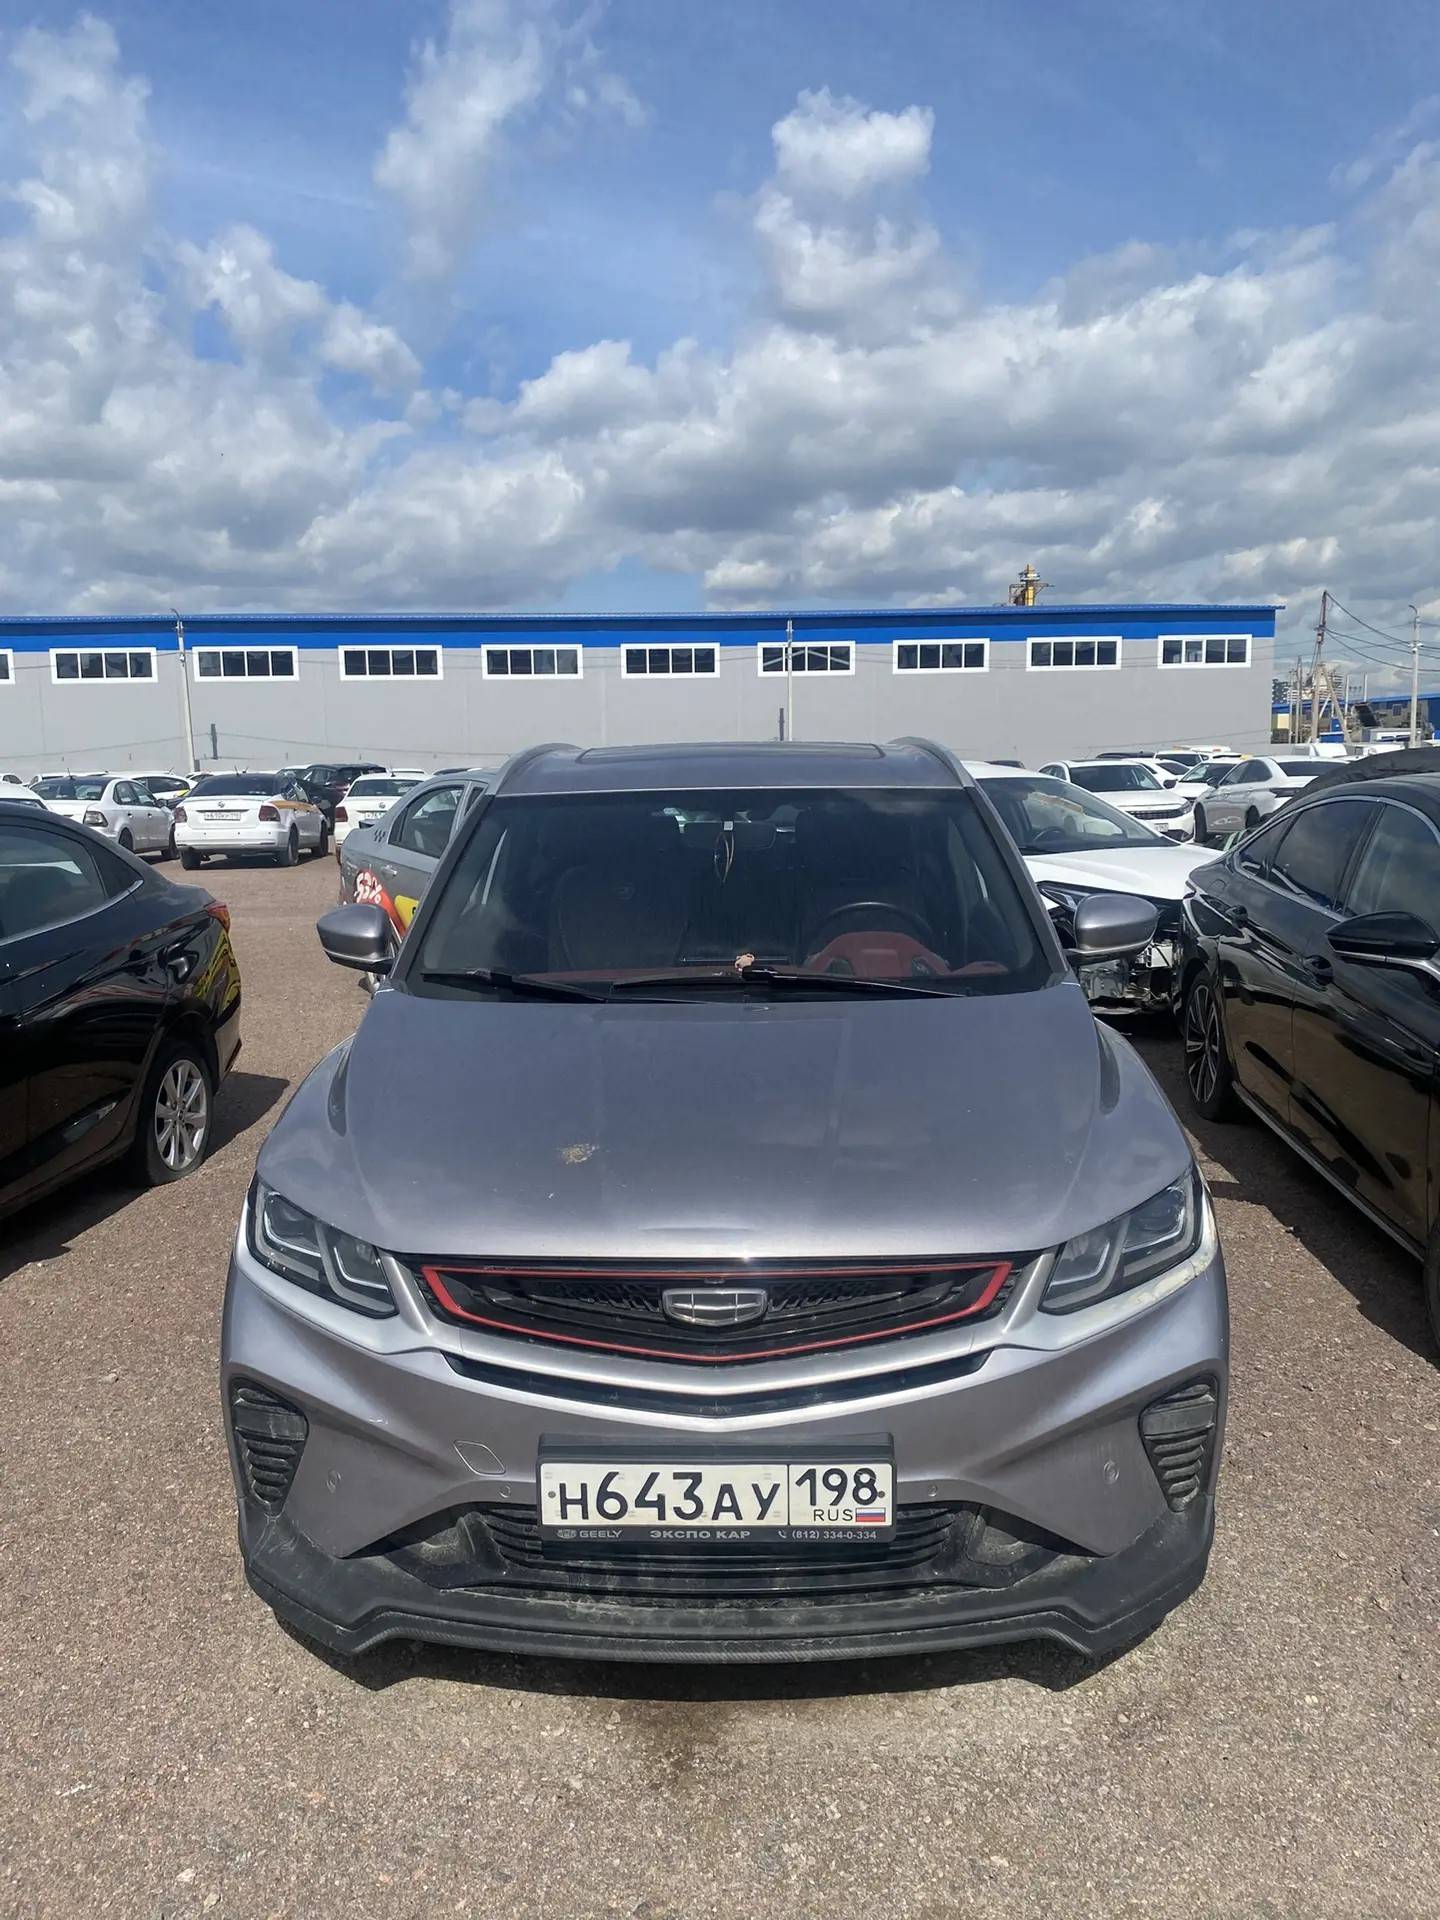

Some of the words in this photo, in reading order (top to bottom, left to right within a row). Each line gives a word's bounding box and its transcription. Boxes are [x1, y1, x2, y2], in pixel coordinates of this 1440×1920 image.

[558, 1471, 781, 1521] Н643АУ
[795, 1467, 878, 1506] 198
[813, 1508, 854, 1522] RUS
[579, 1529, 623, 1539] GEELY
[650, 1530, 711, 1539] ЭКСПО
[715, 1530, 751, 1539] КАР
[792, 1530, 820, 1540] (812)
[823, 1530, 877, 1540] 334-0-334
